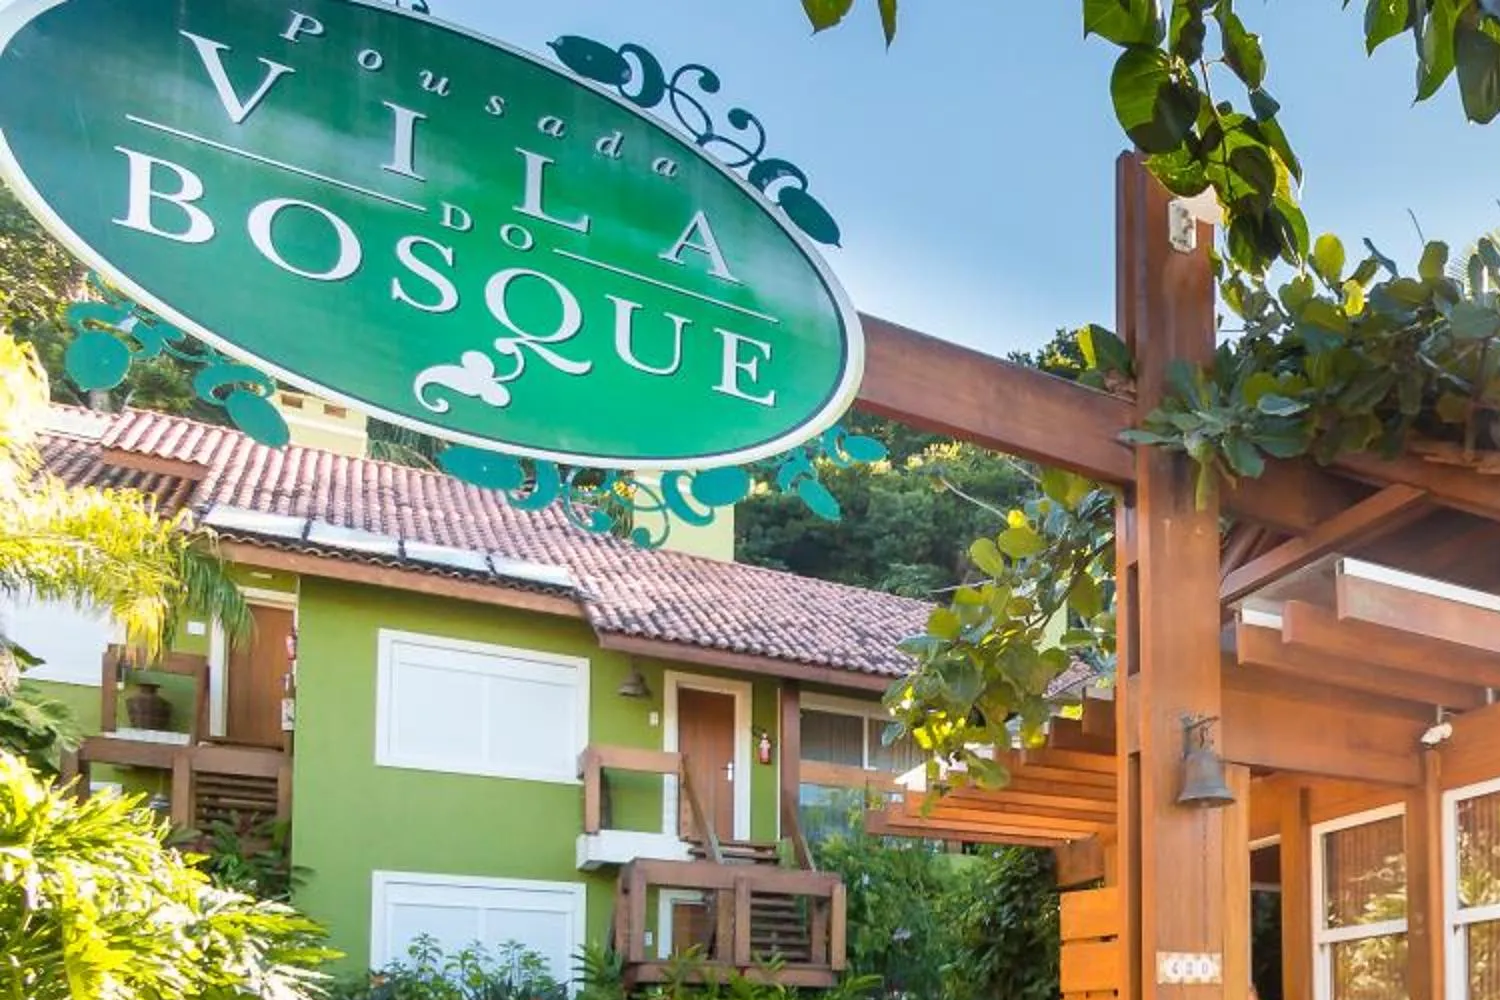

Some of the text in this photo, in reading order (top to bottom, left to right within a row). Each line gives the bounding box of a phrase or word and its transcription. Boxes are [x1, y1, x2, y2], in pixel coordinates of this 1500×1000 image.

[179, 28, 742, 284] VILA
[279, 9, 678, 178] Pousada
[112, 145, 776, 407] BOSQUE
[439, 201, 535, 252] DO
